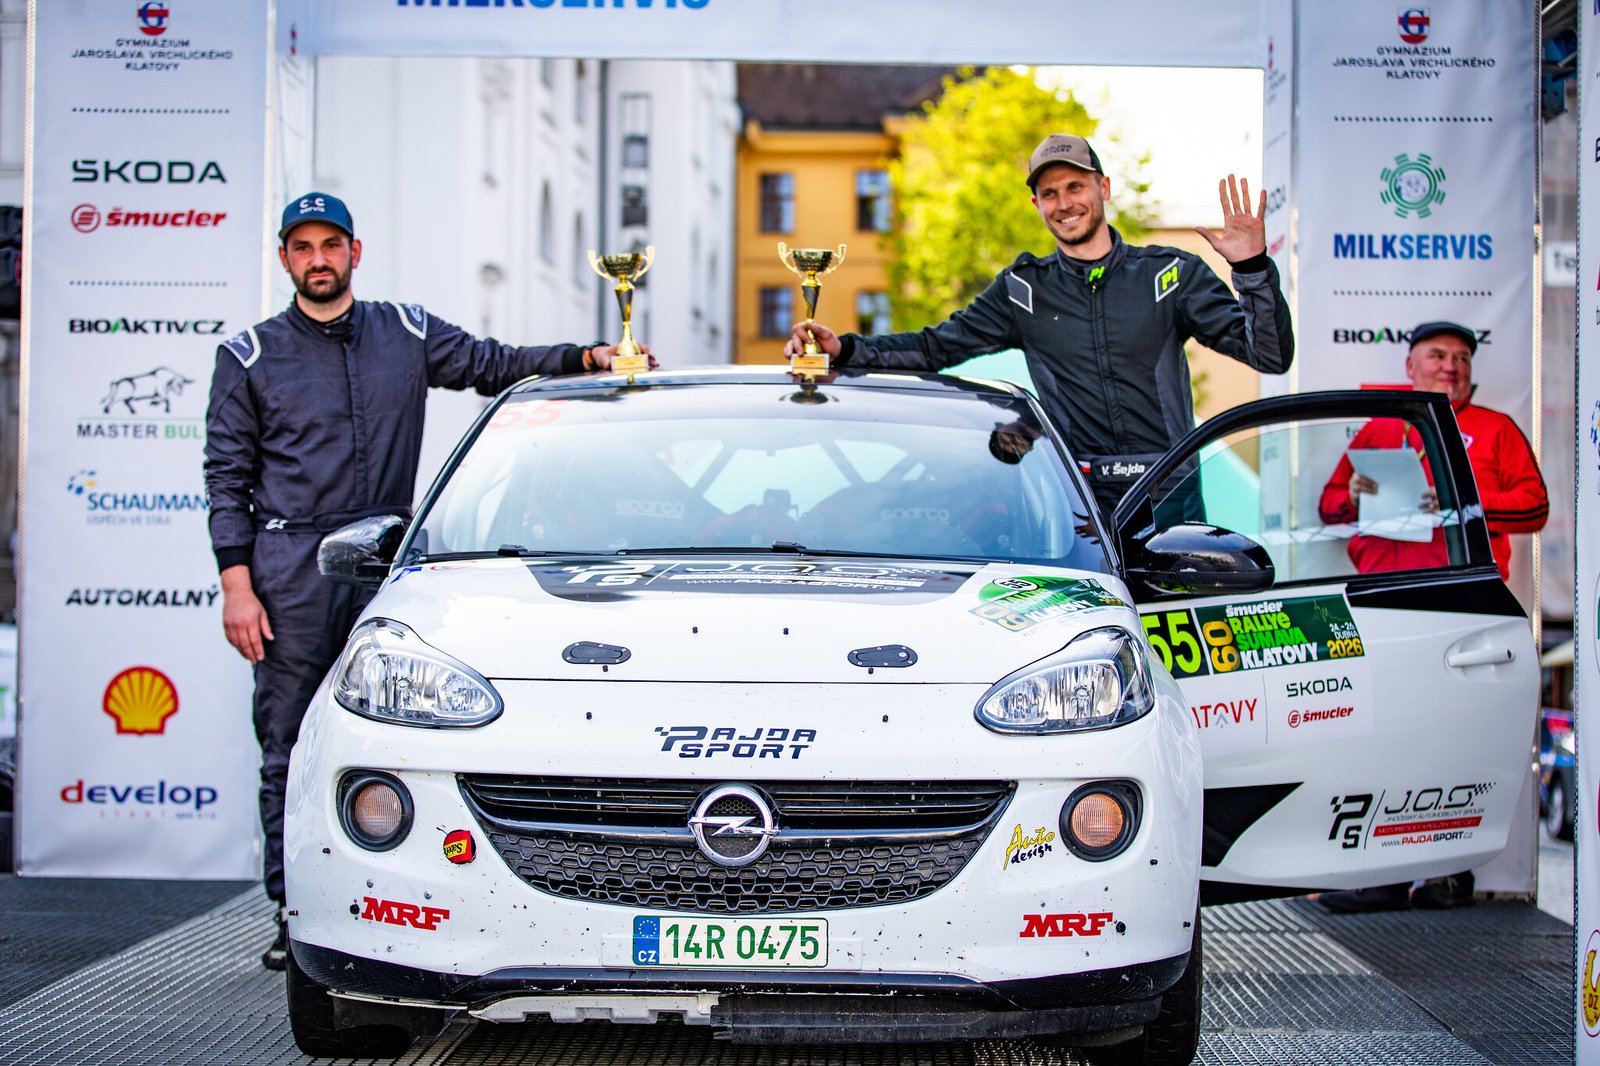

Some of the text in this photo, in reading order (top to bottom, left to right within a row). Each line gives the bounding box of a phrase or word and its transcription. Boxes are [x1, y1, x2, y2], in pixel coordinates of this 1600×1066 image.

[70, 50, 144, 59] JAROSLAVA
[1376, 45, 1451, 56] GYMNÁZIUM
[125, 63, 180, 71] KLATOVY
[1332, 56, 1496, 67] JAROSLAVA VRCHLICKÉHO
[1386, 70, 1441, 79] KLATOVY
[106, 207, 227, 228] šmucler
[1333, 233, 1493, 260] MILKSERVIS
[76, 424, 205, 439] MASTER BUL
[1112, 461, 1146, 477] Šejda
[66, 584, 220, 607] AUTOKALNÝ
[1225, 601, 1283, 618] šmucler
[1240, 642, 1319, 670] KLATOVY
[1327, 638, 1363, 659] 2026
[1302, 706, 1354, 723] šmucler
[655, 726, 817, 751] PAJDA
[678, 743, 810, 759] SPORT
[60, 779, 218, 810] develop
[1003, 824, 1055, 870] Auto
[1011, 843, 1053, 864] design
[361, 896, 450, 931] MRF
[1019, 912, 1113, 938] MRF
[638, 924, 820, 963] CZ 14R 0475
